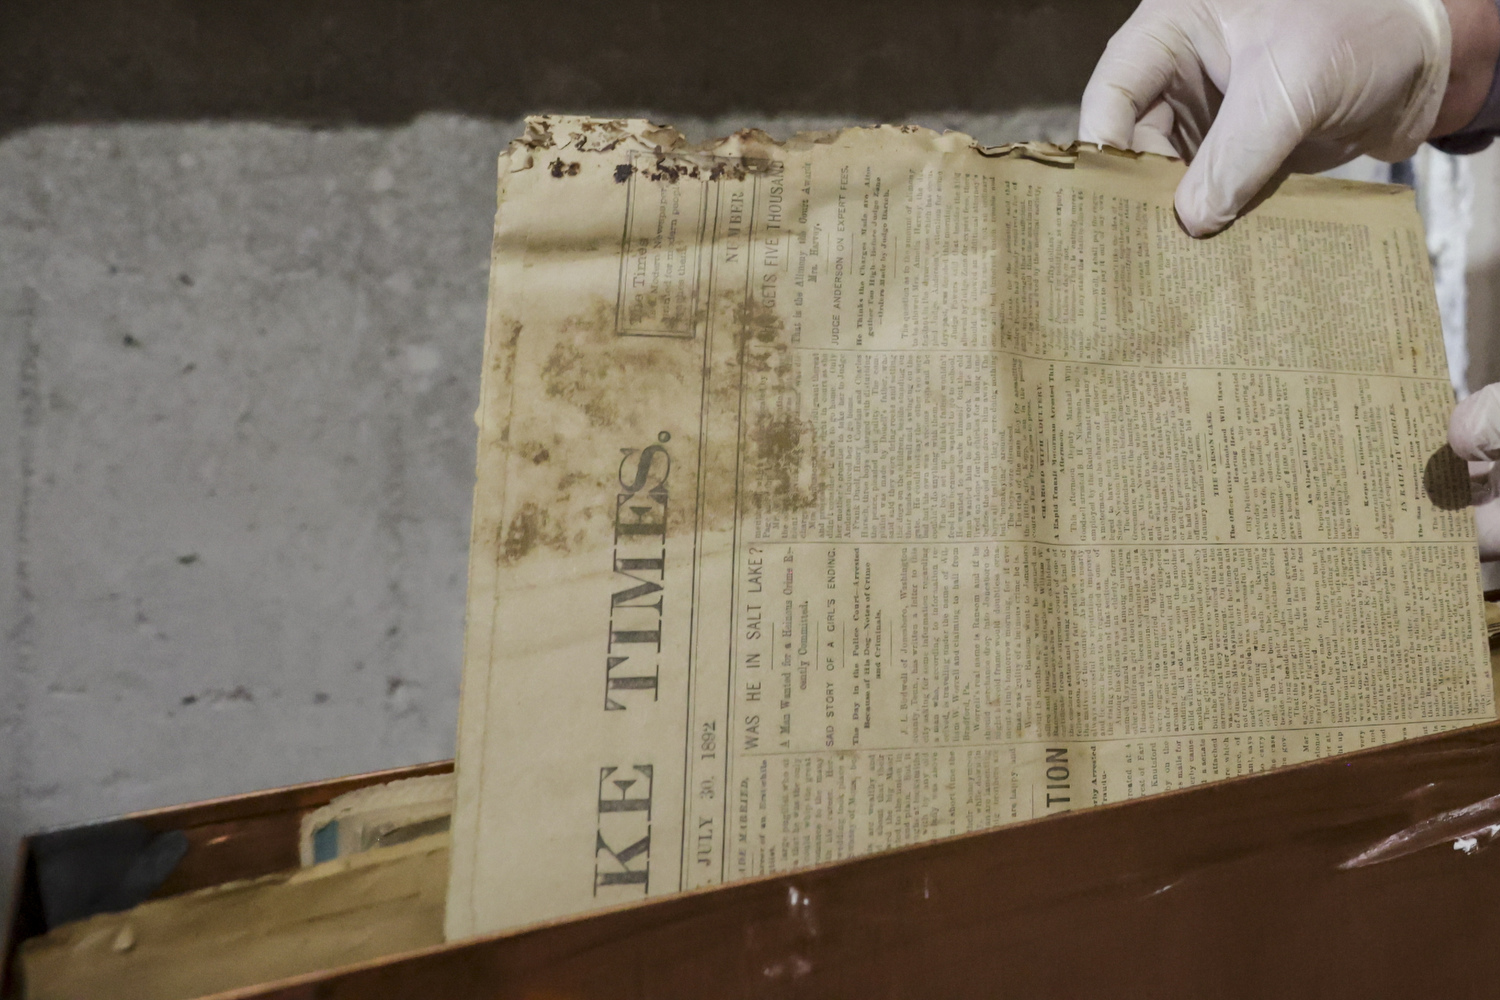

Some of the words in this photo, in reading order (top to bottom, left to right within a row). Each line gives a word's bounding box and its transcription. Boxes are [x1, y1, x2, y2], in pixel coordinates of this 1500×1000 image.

[839, 165, 848, 190] FEES.
[767, 160, 783, 229] THOUSAND
[799, 199, 809, 223] Court
[837, 194, 847, 231] EXPERT
[664, 264, 674, 278] for
[669, 181, 682, 215] peopl
[726, 191, 744, 263] NUMBER
[798, 230, 807, 243] the
[880, 222, 889, 248] Judge
[765, 238, 779, 266] FIVE
[836, 238, 845, 251] ON
[880, 252, 888, 261] by
[631, 237, 647, 287] Times
[795, 250, 808, 287] Alimony
[808, 264, 818, 282] Mrs.
[859, 242, 869, 276] Charges
[867, 308, 876, 337] gether
[872, 200, 881, 226] Judge
[651, 254, 661, 293] Modern
[833, 257, 844, 309] ANDERSON
[763, 274, 778, 308] GETS
[794, 291, 804, 305] the
[857, 298, 865, 328] Thinks
[792, 322, 802, 343] That
[831, 314, 841, 345] JUDGE
[856, 334, 863, 345] He
[1217, 381, 1225, 401] Have
[1206, 411, 1214, 435] CASE.
[1402, 407, 1413, 435] Coming
[1209, 438, 1218, 474] CARSON
[1300, 433, 1308, 455] Horse
[1406, 440, 1414, 457] Line
[1231, 450, 1241, 482] Hearing
[1303, 459, 1313, 488] Alleged
[1394, 448, 1406, 496] RAILWAY
[1224, 471, 1232, 493] Gives
[1361, 482, 1371, 506] Keeps
[1226, 495, 1234, 521] Officer
[1306, 493, 1313, 504] An
[1052, 504, 1060, 530] Rapid
[603, 430, 671, 711] TIMES.
[748, 547, 763, 592] LAKE?
[827, 547, 836, 589] ENDING.
[864, 593, 870, 602] of
[747, 604, 762, 639] SALT
[799, 600, 808, 655] Committed.
[827, 598, 835, 631] GIRL'S
[746, 653, 761, 668] IN
[782, 653, 791, 665] for
[827, 657, 835, 670] OF
[798, 661, 809, 689] cently
[864, 678, 870, 688] of
[746, 682, 760, 701] HE
[781, 672, 791, 709] Wanted
[826, 682, 835, 717] STORY
[853, 685, 859, 694] in
[781, 713, 790, 734] Man
[853, 702, 861, 719] Day
[701, 720, 716, 760] 1892
[745, 715, 760, 749] WAS
[781, 740, 790, 748] A
[826, 725, 834, 746] SAD
[1045, 748, 1070, 808] TION
[594, 764, 655, 896] KE
[698, 817, 714, 865] JULY
